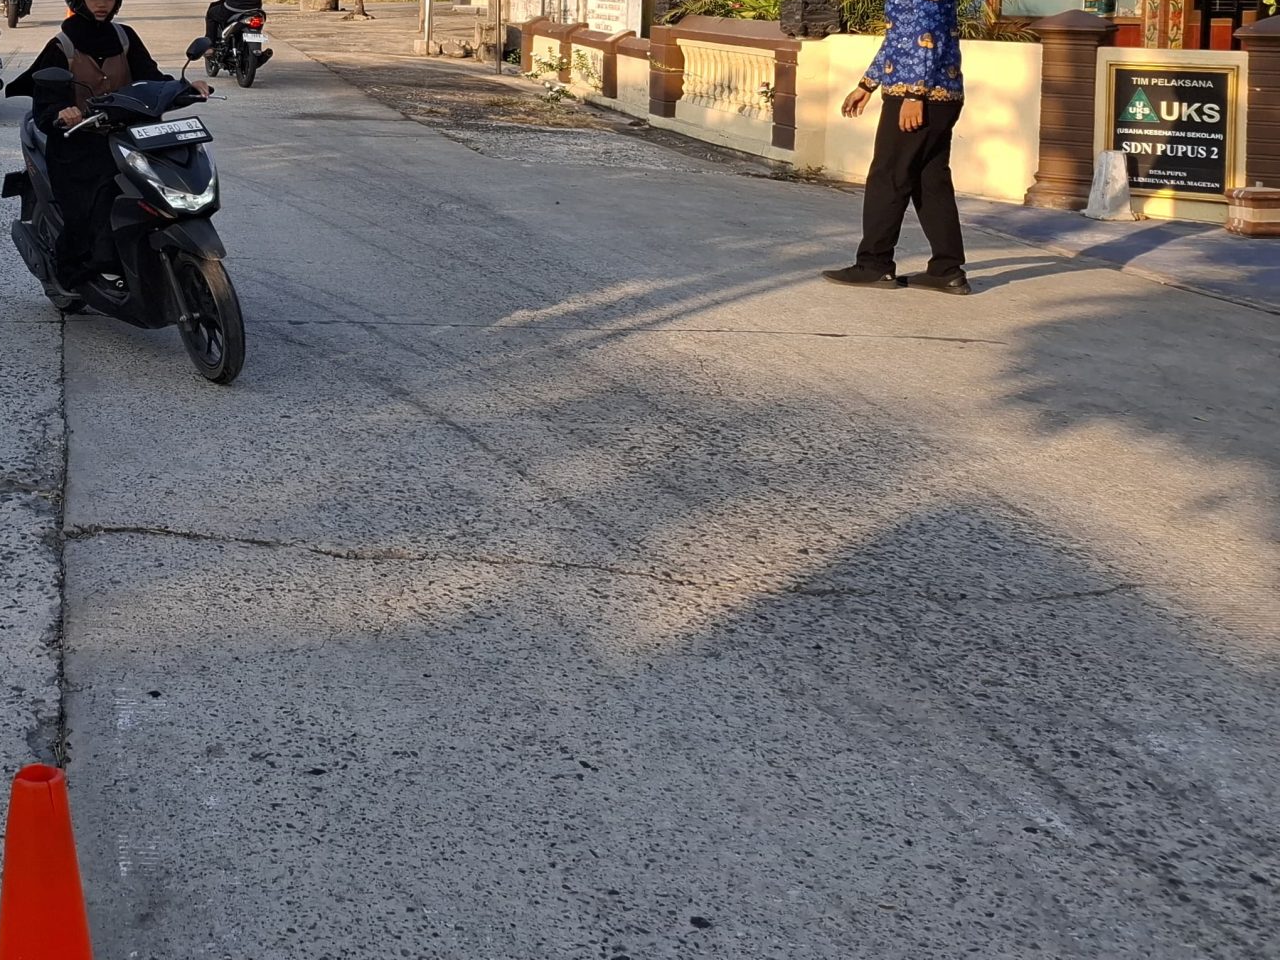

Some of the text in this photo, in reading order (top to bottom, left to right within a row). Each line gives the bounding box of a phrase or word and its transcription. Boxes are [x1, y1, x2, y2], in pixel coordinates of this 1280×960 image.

[1131, 77, 1213, 88] TIM PELAKSANA
[1160, 101, 1220, 123] UKS
[136, 128, 149, 137] AE
[1117, 127, 1223, 140] (USAHA KESEHATAN SEKOLAH)
[1122, 141, 1218, 158] SDN PUPUS 2
